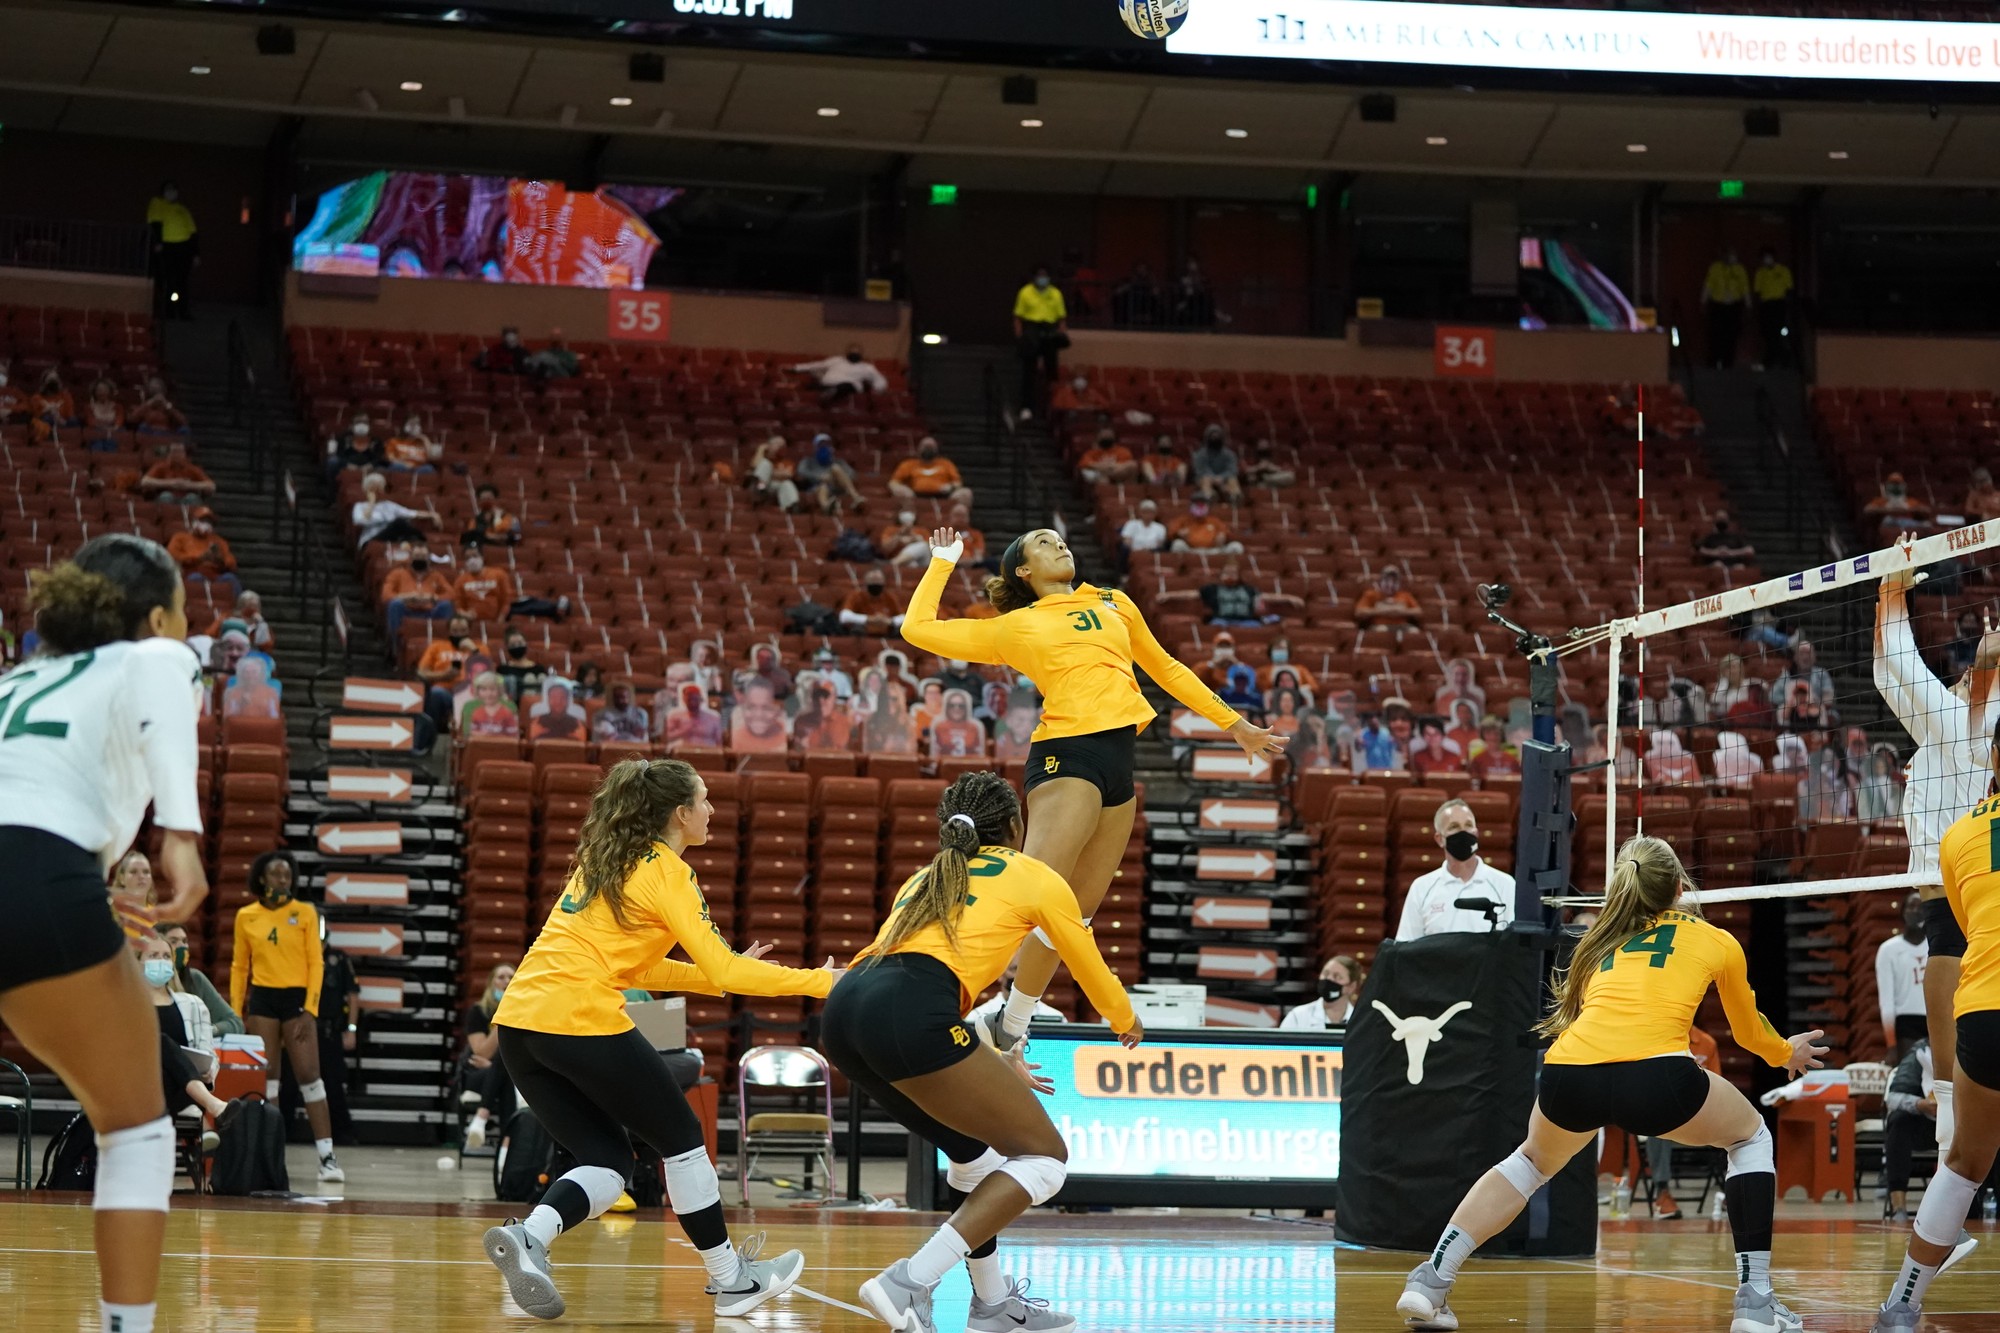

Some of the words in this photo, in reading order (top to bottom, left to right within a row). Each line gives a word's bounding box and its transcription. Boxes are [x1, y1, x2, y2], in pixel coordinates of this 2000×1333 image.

[745, 0, 793, 19] PM
[1319, 22, 1502, 49] AMERICAN
[1515, 29, 1652, 55] CAMPUS
[1697, 31, 1787, 62] Where
[1798, 36, 1916, 65] students
[1927, 37, 1981, 67] love
[618, 300, 661, 332] 35
[1443, 336, 1486, 367] 34
[1946, 524, 1986, 552] TEXAS
[1067, 609, 1102, 631] 31
[1694, 596, 1723, 618] TEXAS
[0, 652, 95, 740] 2
[267, 927, 278, 946] 4
[1097, 1051, 1226, 1096] order
[1847, 1069, 1888, 1081] TEXA
[1056, 1114, 1341, 1173] htyfineburge
